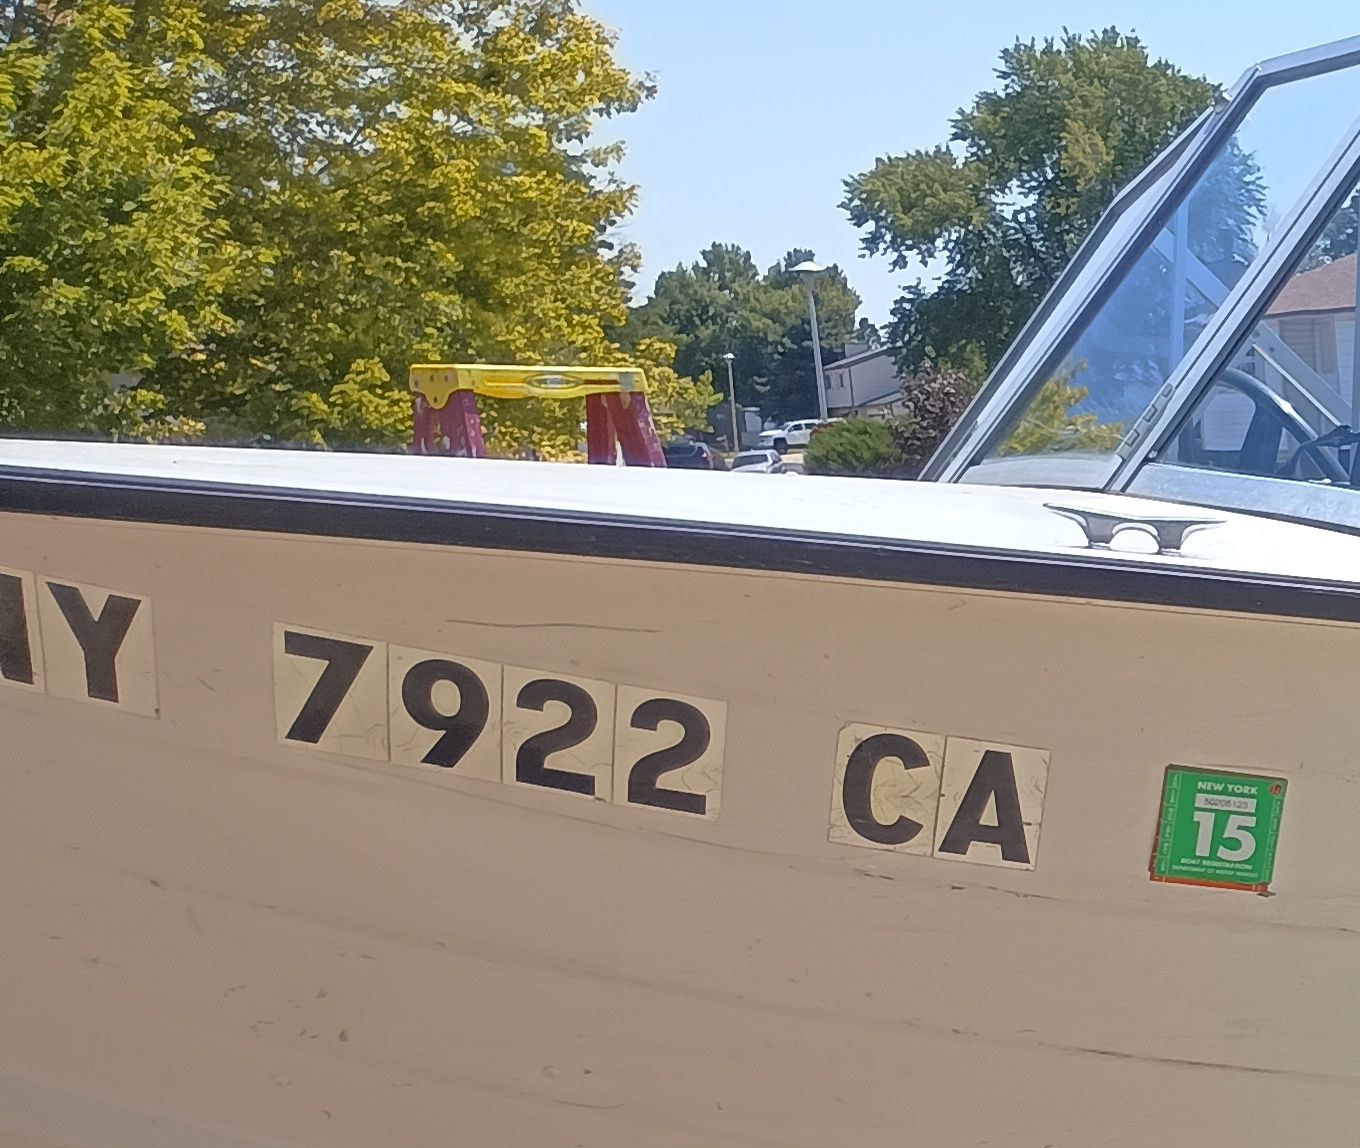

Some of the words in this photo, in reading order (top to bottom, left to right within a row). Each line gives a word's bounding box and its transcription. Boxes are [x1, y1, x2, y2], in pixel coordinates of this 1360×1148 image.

[284, 630, 711, 815] 7922
[842, 733, 1031, 864] CA
[1197, 781, 1225, 791] NEW
[1227, 784, 1258, 795] YORK
[1193, 811, 1257, 861] 15
